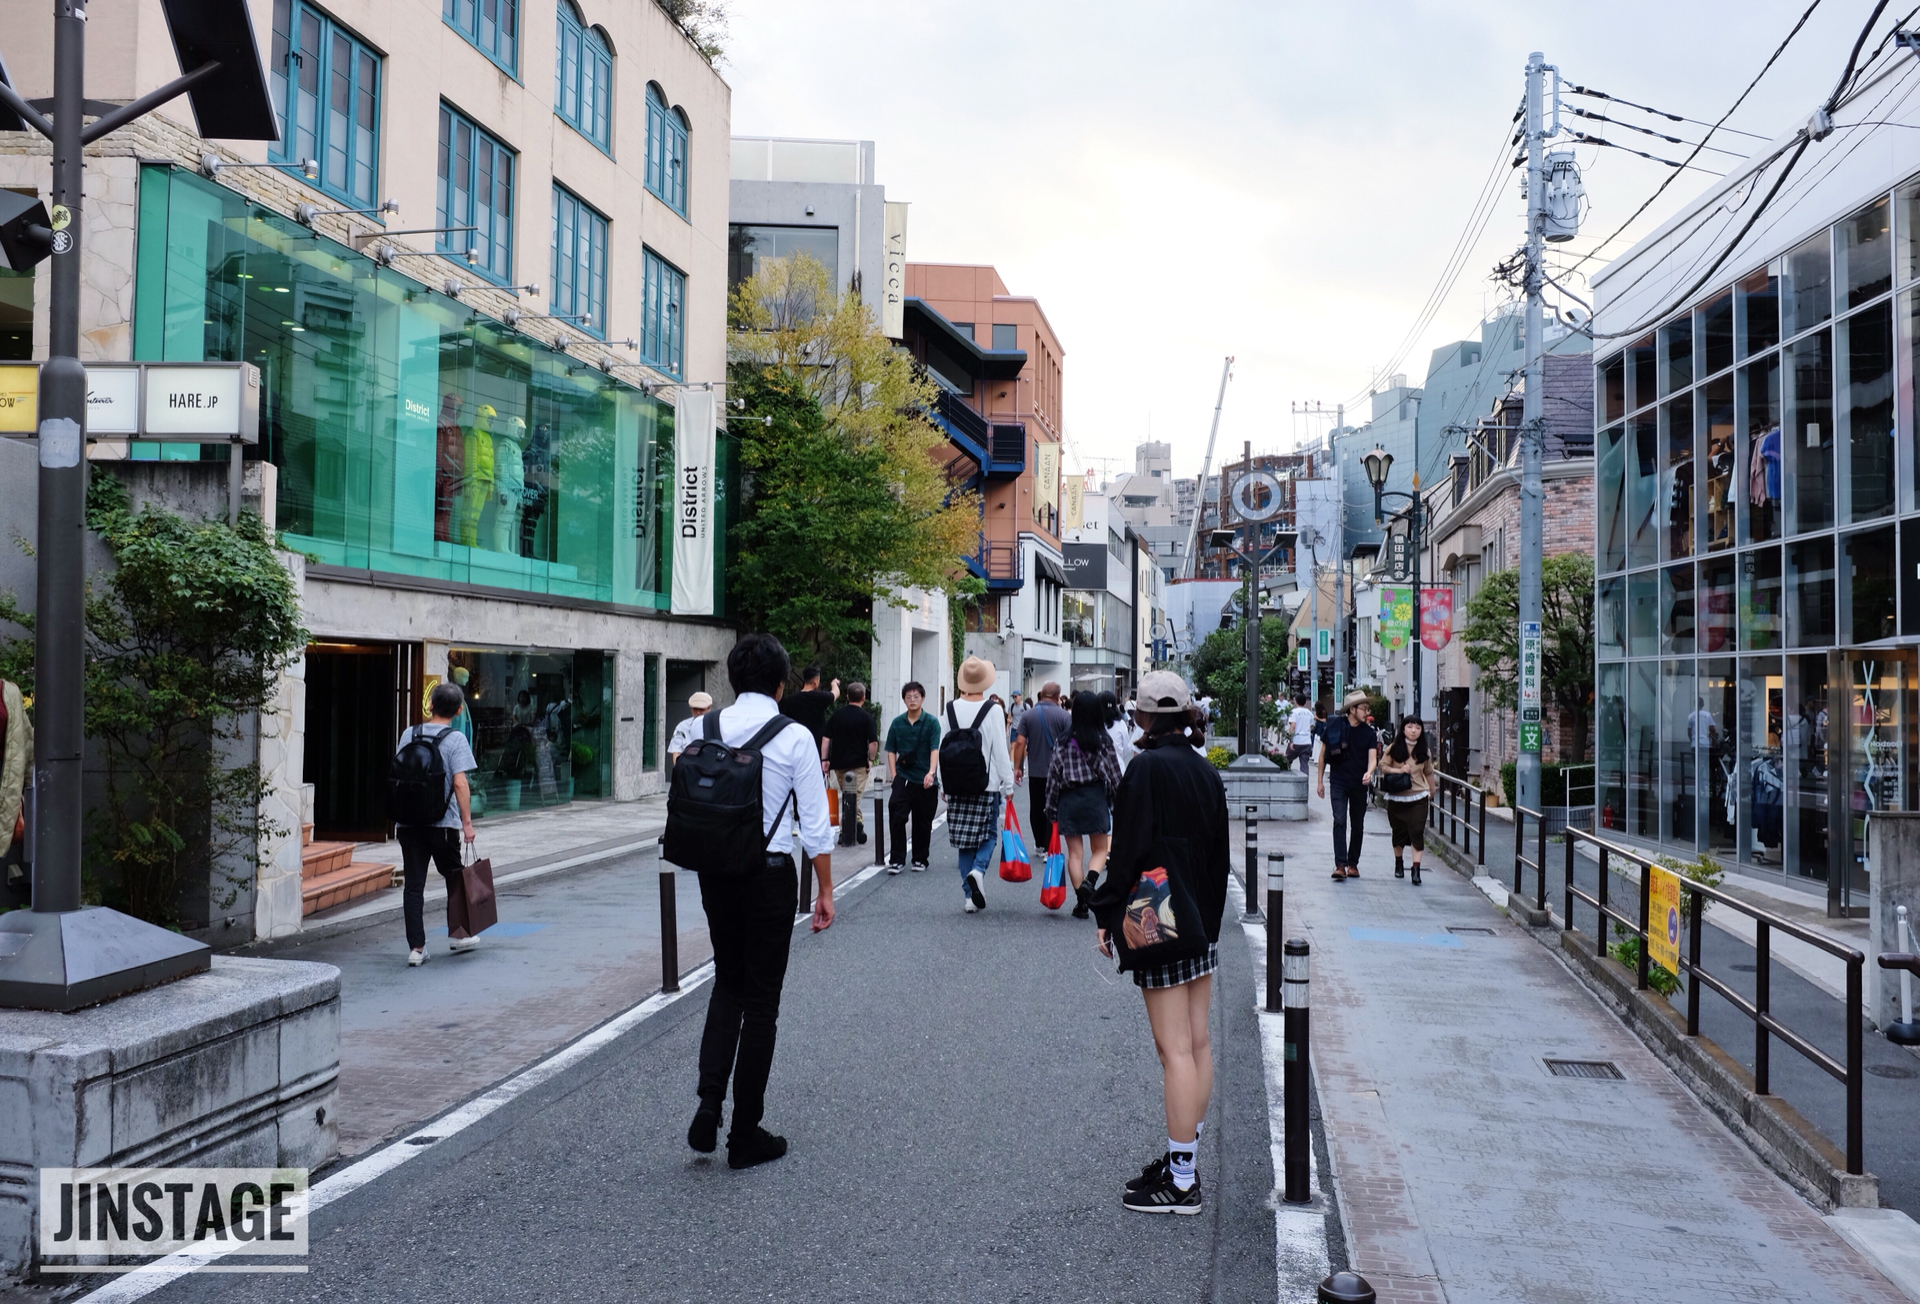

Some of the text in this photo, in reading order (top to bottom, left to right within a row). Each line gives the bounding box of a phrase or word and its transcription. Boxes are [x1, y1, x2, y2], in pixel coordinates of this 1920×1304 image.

[888, 233, 904, 306] vicca
[405, 398, 430, 417] District
[682, 466, 698, 538] District
[1524, 731, 1538, 746] 文
